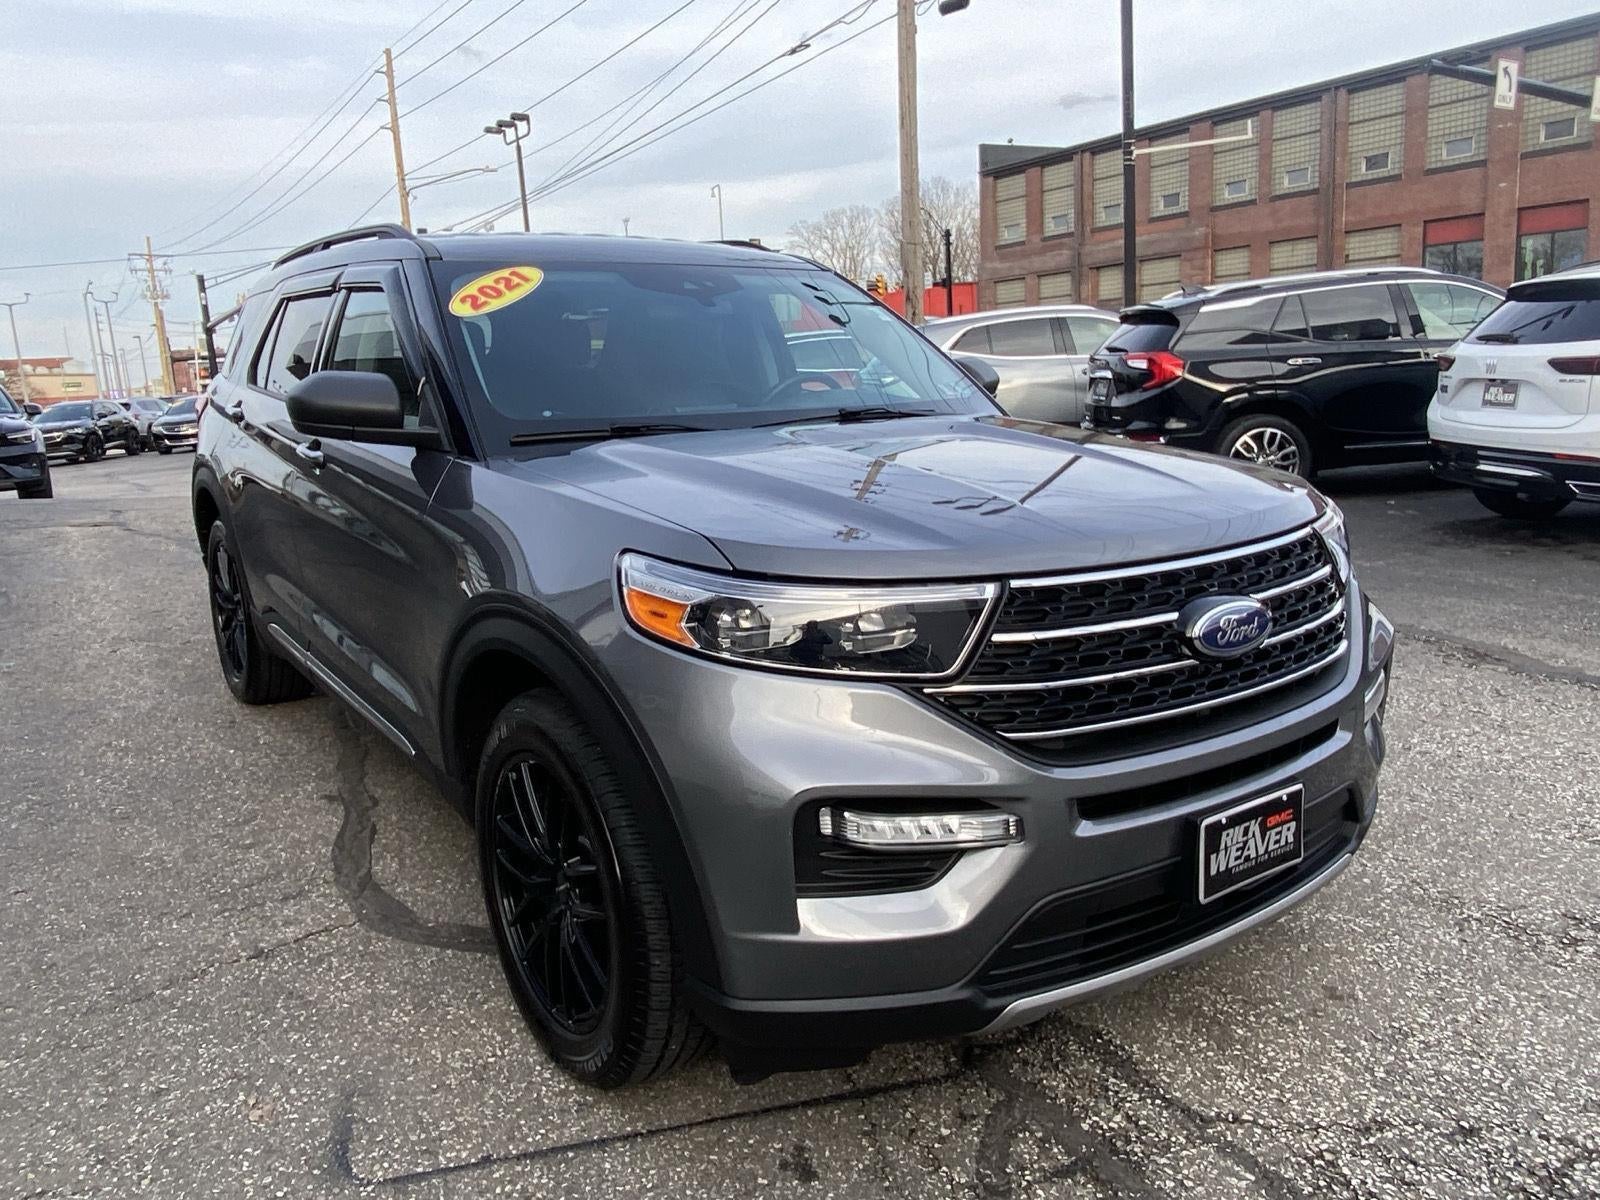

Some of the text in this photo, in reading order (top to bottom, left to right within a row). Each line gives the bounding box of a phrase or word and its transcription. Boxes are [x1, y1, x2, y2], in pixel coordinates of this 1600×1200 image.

[459, 270, 531, 312] 2021
[1217, 613, 1260, 646] Ford
[1210, 820, 1297, 877] WEAVER
[1220, 808, 1294, 850] RICK GMC
